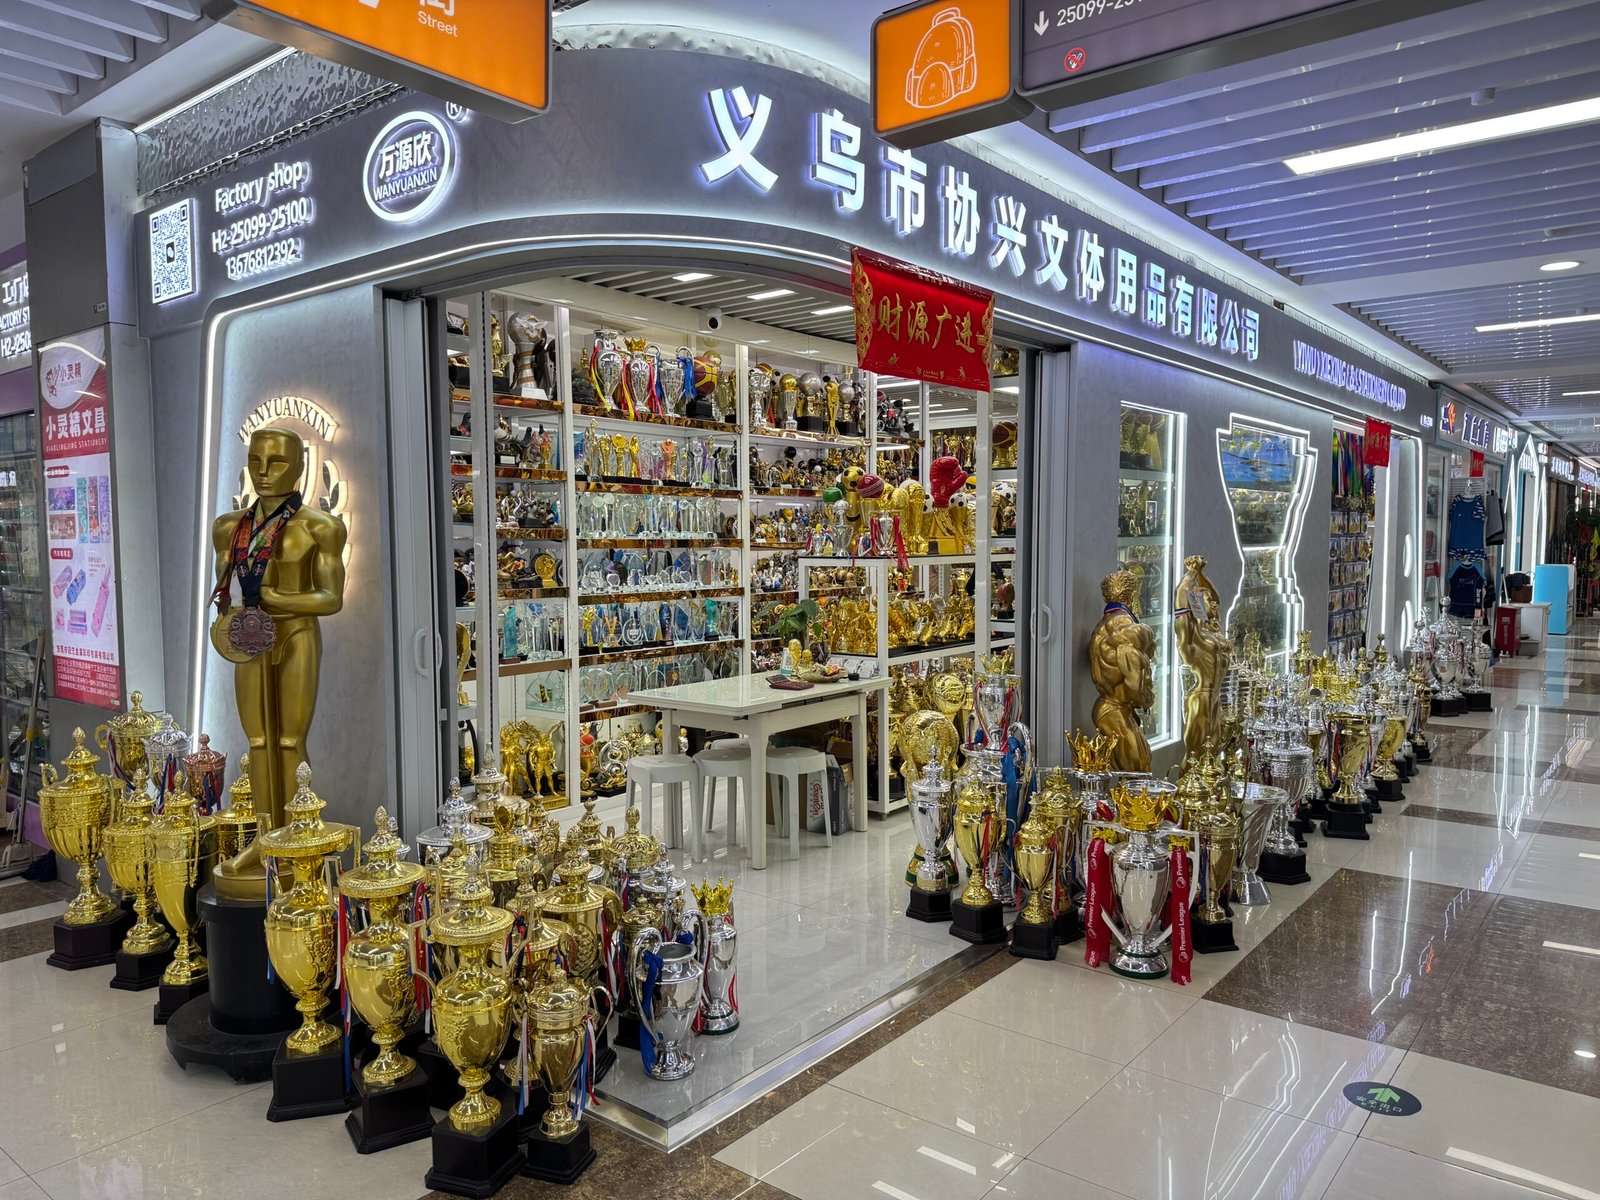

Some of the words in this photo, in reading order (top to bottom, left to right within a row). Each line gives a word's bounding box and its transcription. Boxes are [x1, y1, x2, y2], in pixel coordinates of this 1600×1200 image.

[418, 10, 458, 37] Street
[378, 130, 433, 180] 万源欣
[215, 176, 264, 213] Factory
[267, 161, 304, 192] shop
[373, 166, 438, 201] WANYUANXIN
[211, 196, 308, 254] H2-25099-25100
[699, 84, 1262, 362] 义乌市协兴文体用品有限公司
[225, 237, 296, 279] 13676812392
[877, 292, 976, 354] 财源广进
[45, 406, 106, 441] 小灵精文具
[237, 396, 332, 443] WANYUANXIN
[1089, 882, 1098, 905] League
[1087, 904, 1095, 929] Premier
[1179, 902, 1187, 926] League
[1355, 1095, 1403, 1113] 安全出口
